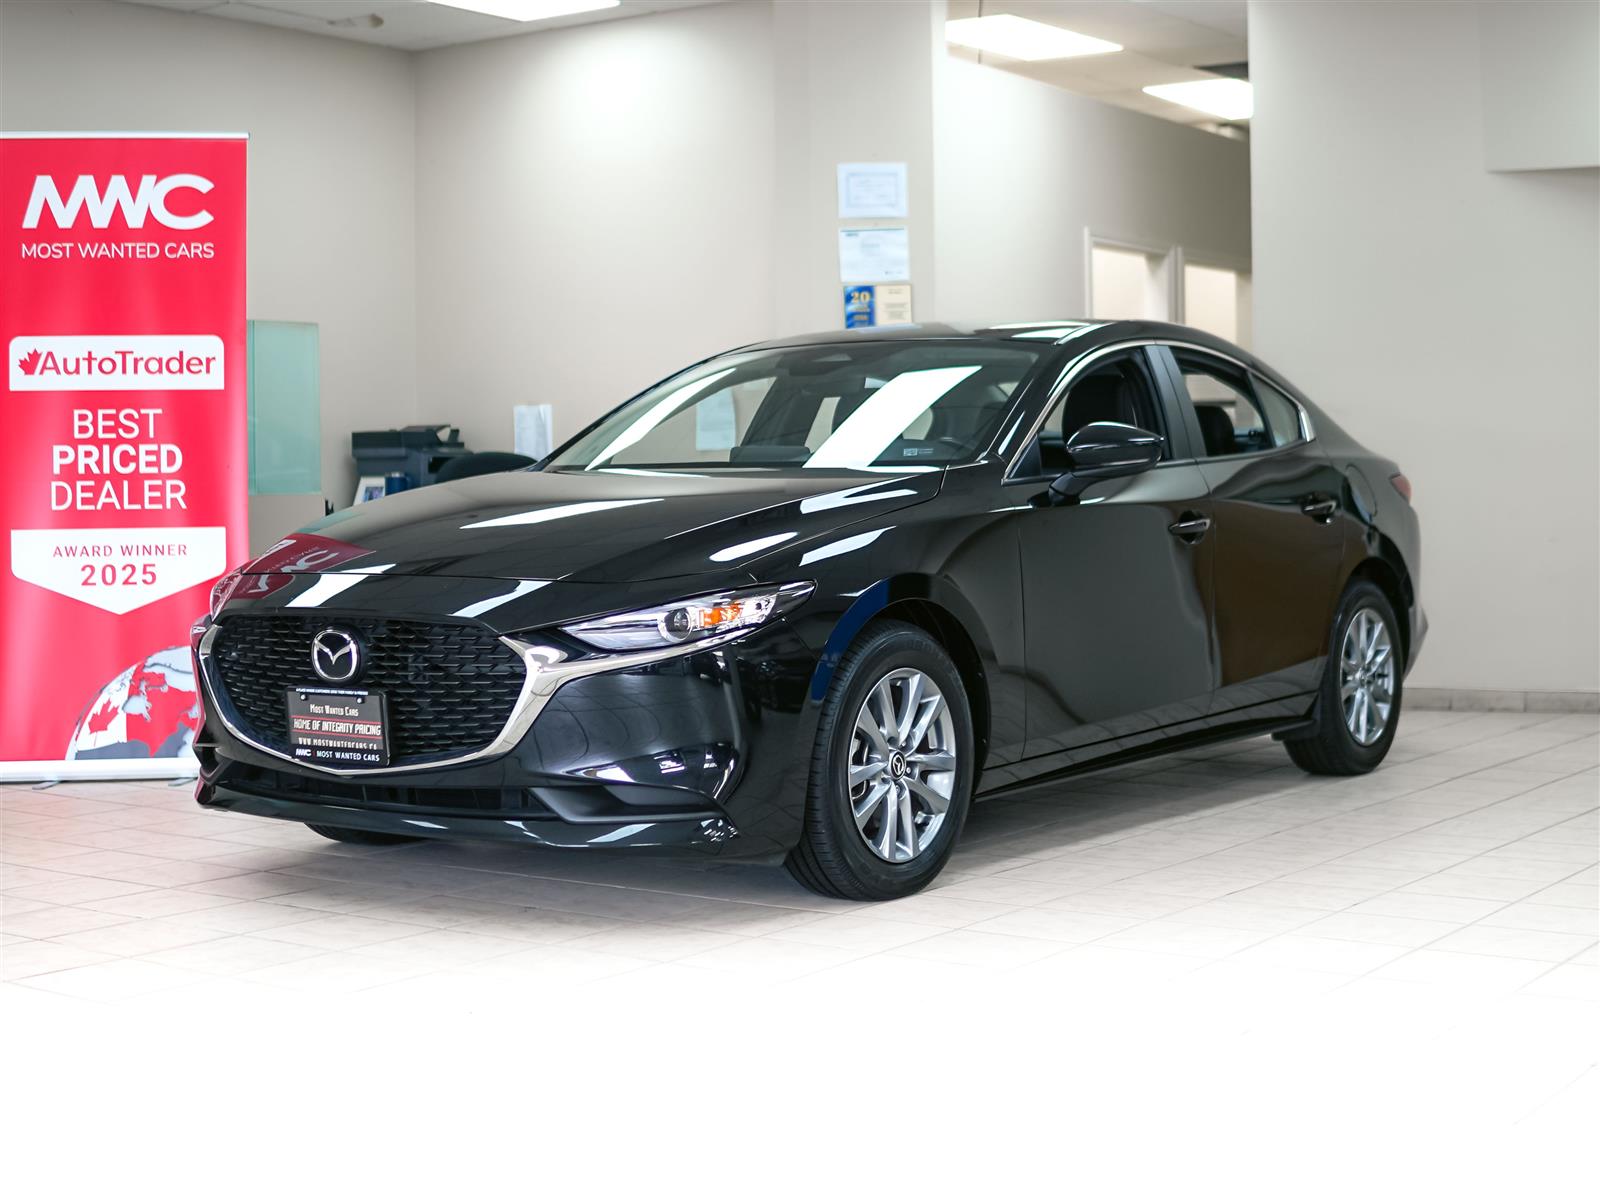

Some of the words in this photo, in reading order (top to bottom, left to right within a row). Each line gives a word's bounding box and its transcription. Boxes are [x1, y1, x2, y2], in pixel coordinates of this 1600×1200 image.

[22, 173, 214, 230] MWC
[21, 243, 74, 259] MOST
[77, 243, 160, 259] WANTED
[165, 243, 215, 259] CARS
[39, 350, 216, 376] AutoTrader
[73, 408, 163, 439] BEST
[52, 444, 183, 475] PRICED
[50, 479, 188, 511] DEALER
[53, 544, 113, 557] AWARD
[121, 544, 188, 556] WINNER
[80, 563, 157, 586] 2025
[293, 718, 310, 730] HOME
[312, 720, 321, 731] OF
[321, 721, 354, 734] INTEGRITY
[355, 723, 382, 736] PRICING
[335, 753, 362, 761] WANTED
[363, 754, 380, 762] CARS
